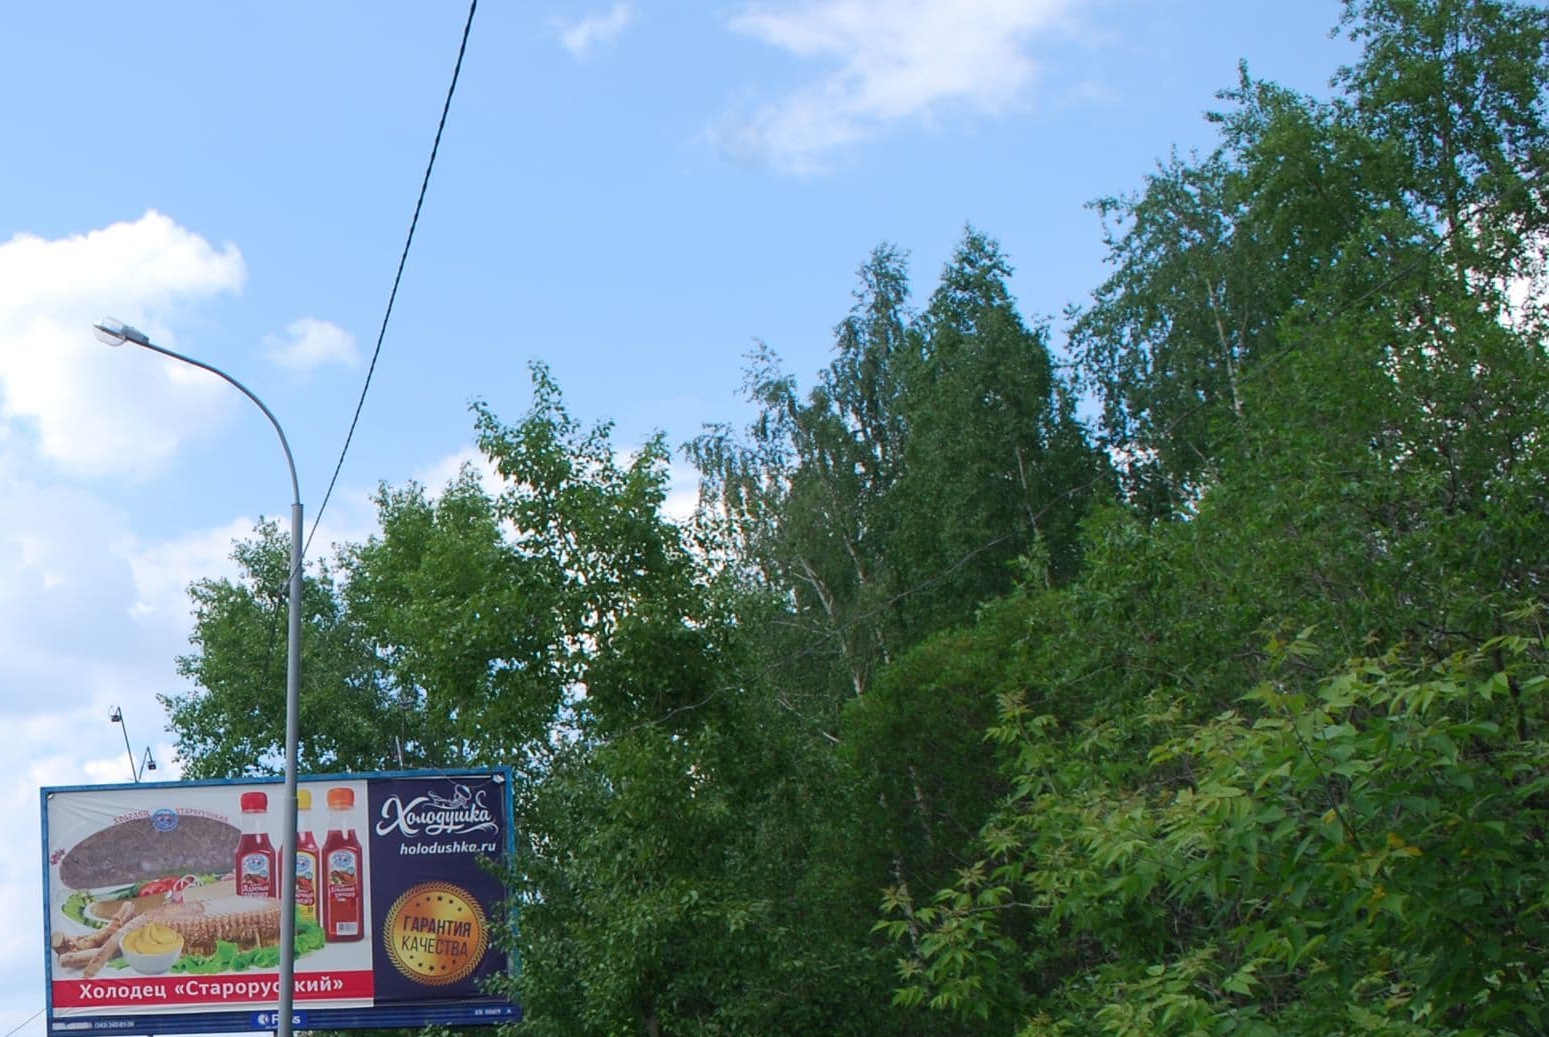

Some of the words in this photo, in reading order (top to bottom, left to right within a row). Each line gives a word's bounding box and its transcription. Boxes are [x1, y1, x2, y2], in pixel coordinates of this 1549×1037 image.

[376, 792, 498, 837] Холодушка
[400, 842, 496, 855] holodushka.ru
[403, 915, 471, 938] ГАРАНТИЯ
[402, 935, 468, 957] КАЧЕСТВА
[79, 983, 166, 999] Холодец
[175, 977, 344, 998] «Староруский»
